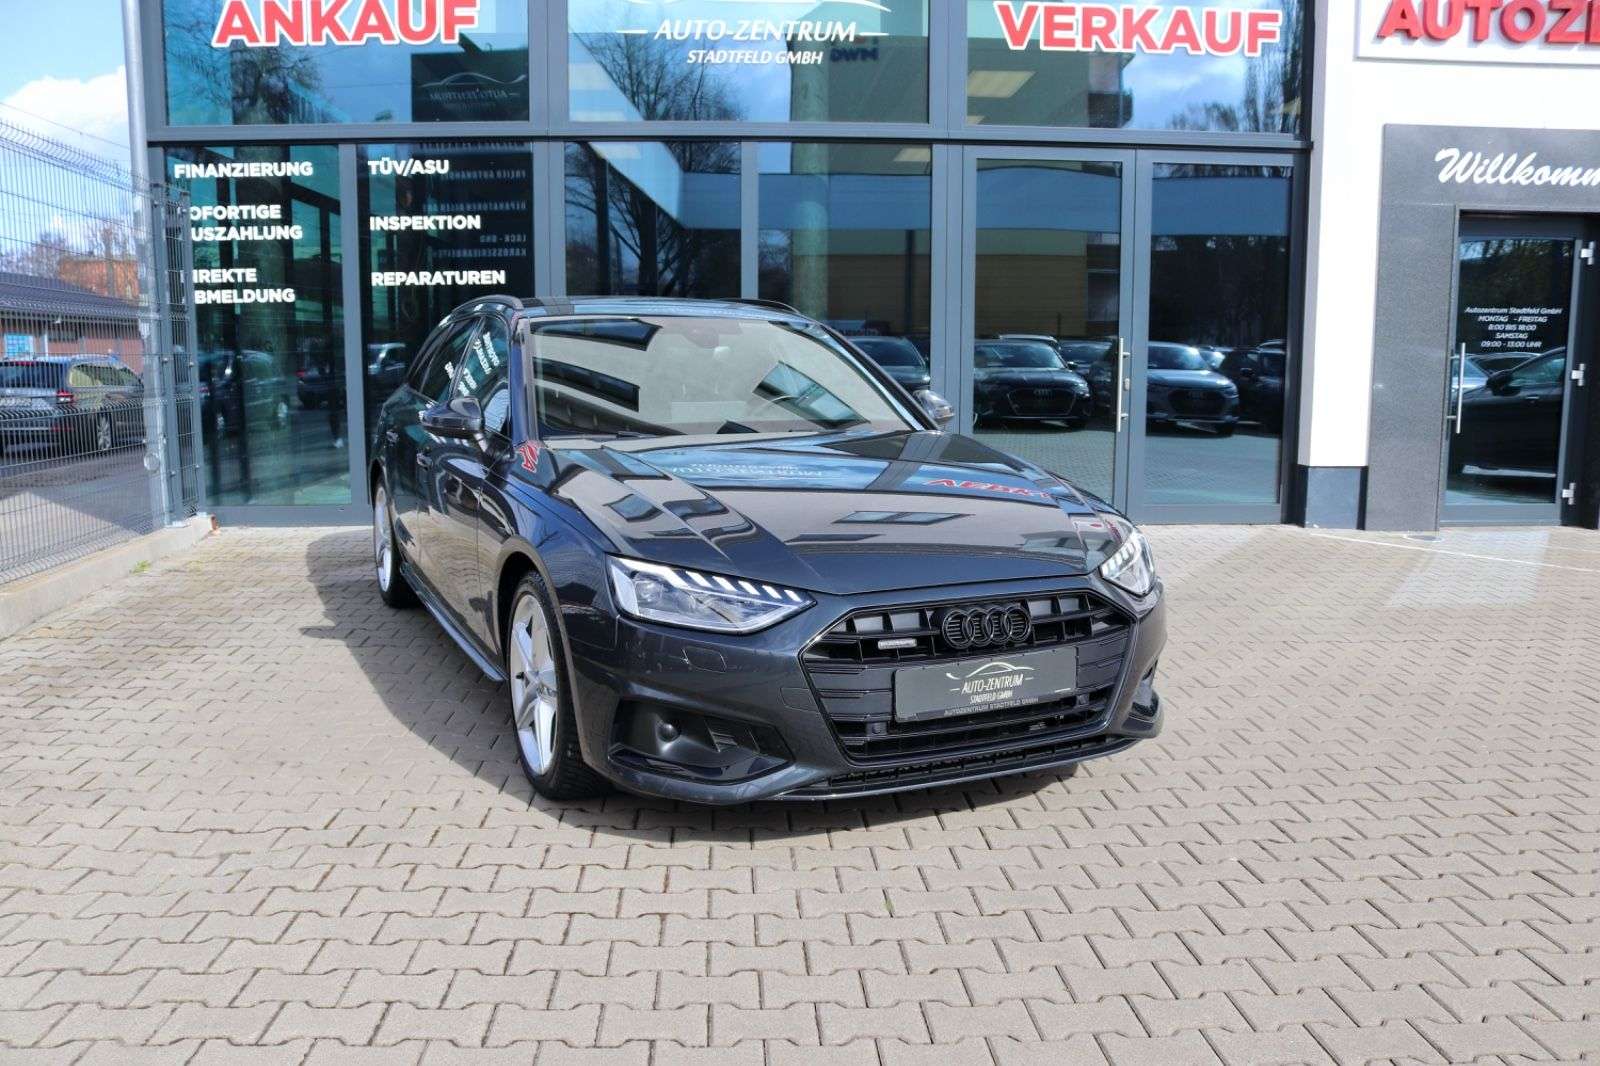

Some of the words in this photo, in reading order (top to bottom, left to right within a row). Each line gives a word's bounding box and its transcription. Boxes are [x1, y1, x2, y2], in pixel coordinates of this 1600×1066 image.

[212, 0, 479, 47] ANKAUF
[654, 19, 856, 43] AUTO-ZENTRUM
[997, 3, 1281, 57] VERKAUF
[1376, 0, 1600, 44] AUTOZ
[687, 50, 772, 65] STADTFELD
[775, 51, 823, 66] GMBH
[173, 161, 314, 179] FINANZIERUNG
[367, 156, 450, 177] TÜV/ASU
[183, 204, 282, 220] OFORTIGE
[369, 214, 481, 231] INSPEKTION
[184, 225, 303, 241] USZAHLUNG
[182, 268, 257, 284] IREKTE
[371, 269, 506, 287] REPARATUREN
[186, 288, 295, 304] BMELDUNG
[961, 674, 1024, 695] AUTO-ZENTRUM
